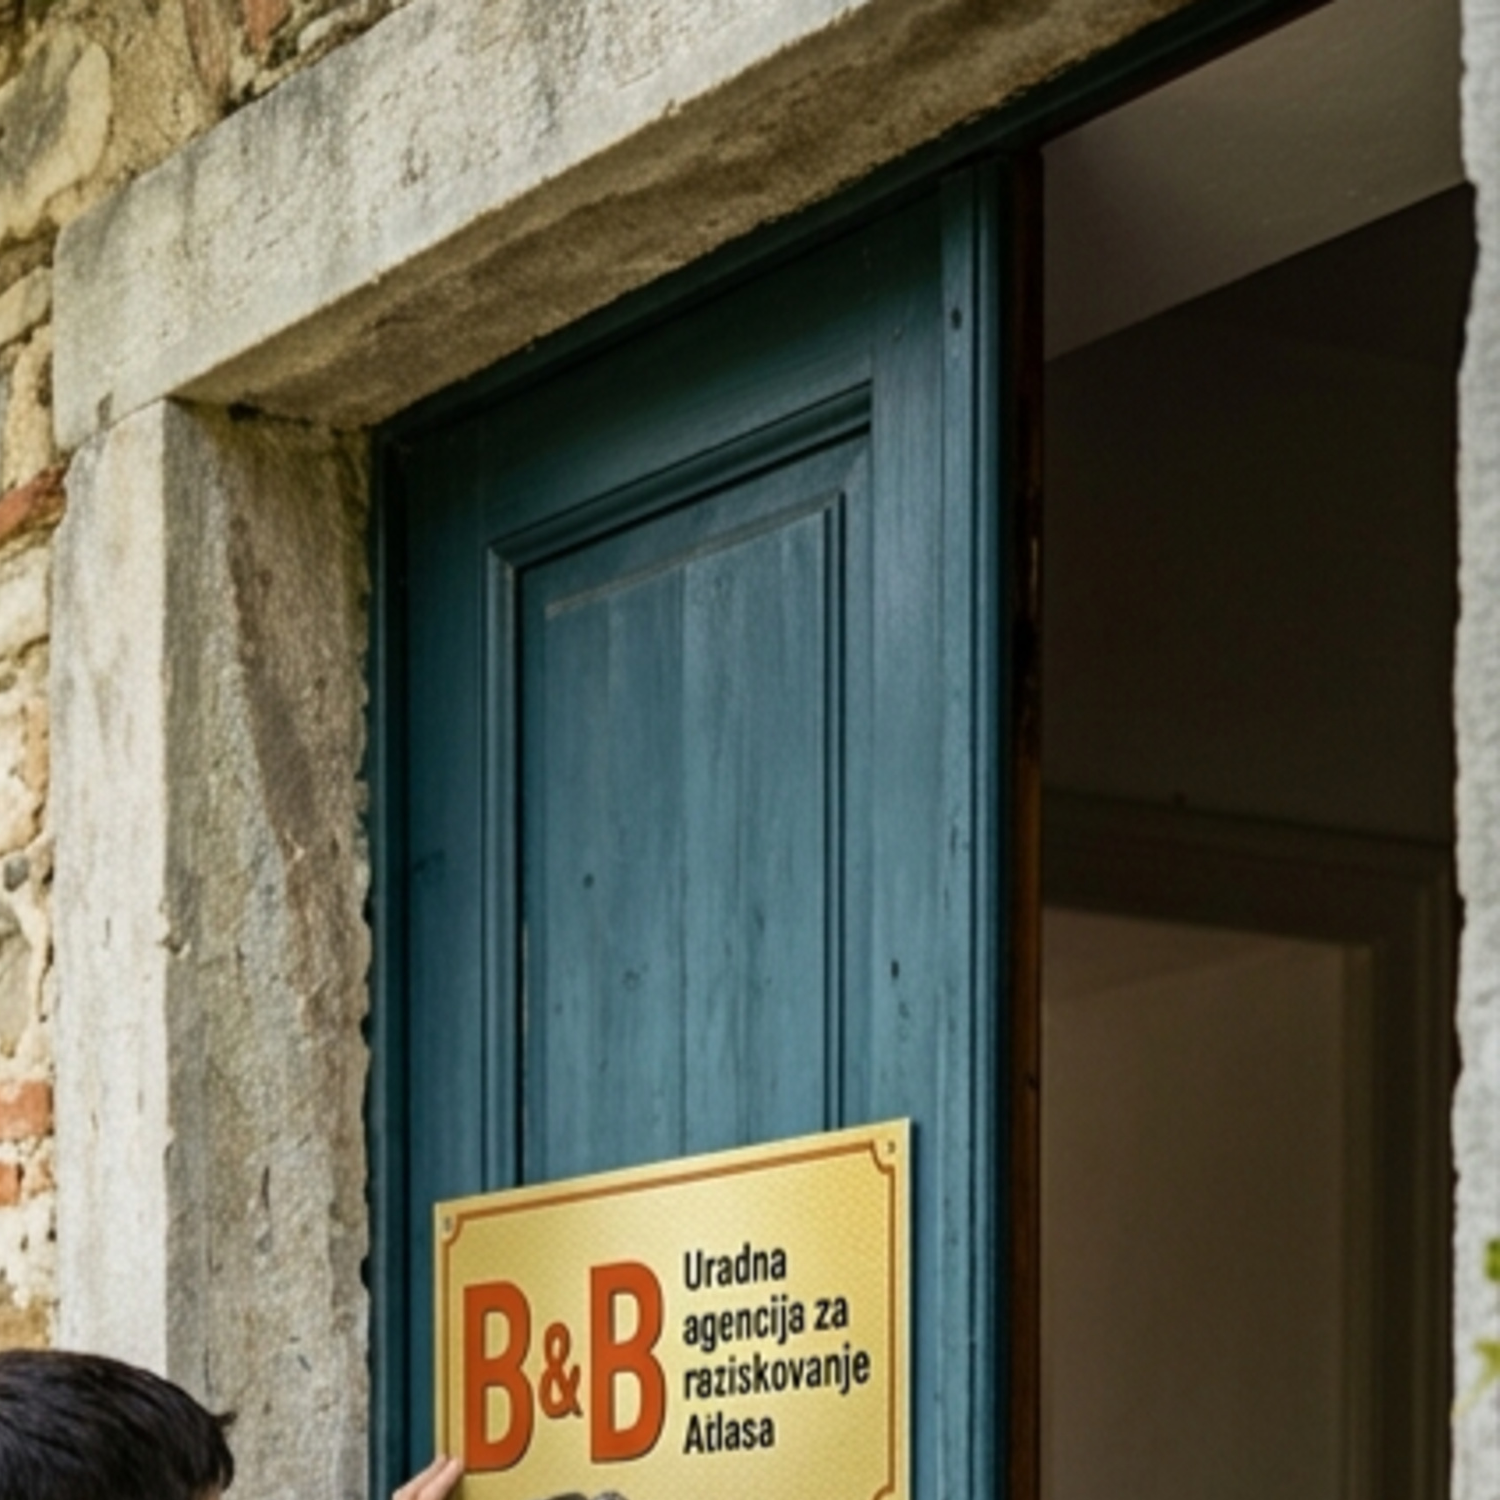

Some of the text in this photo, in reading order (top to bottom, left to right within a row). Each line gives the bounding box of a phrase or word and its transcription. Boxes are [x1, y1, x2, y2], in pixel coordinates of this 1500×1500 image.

[684, 1242, 787, 1291] Uradna
[683, 1294, 849, 1353] agencija za
[463, 1262, 666, 1474] B&B
[684, 1342, 871, 1400] raziskovanje
